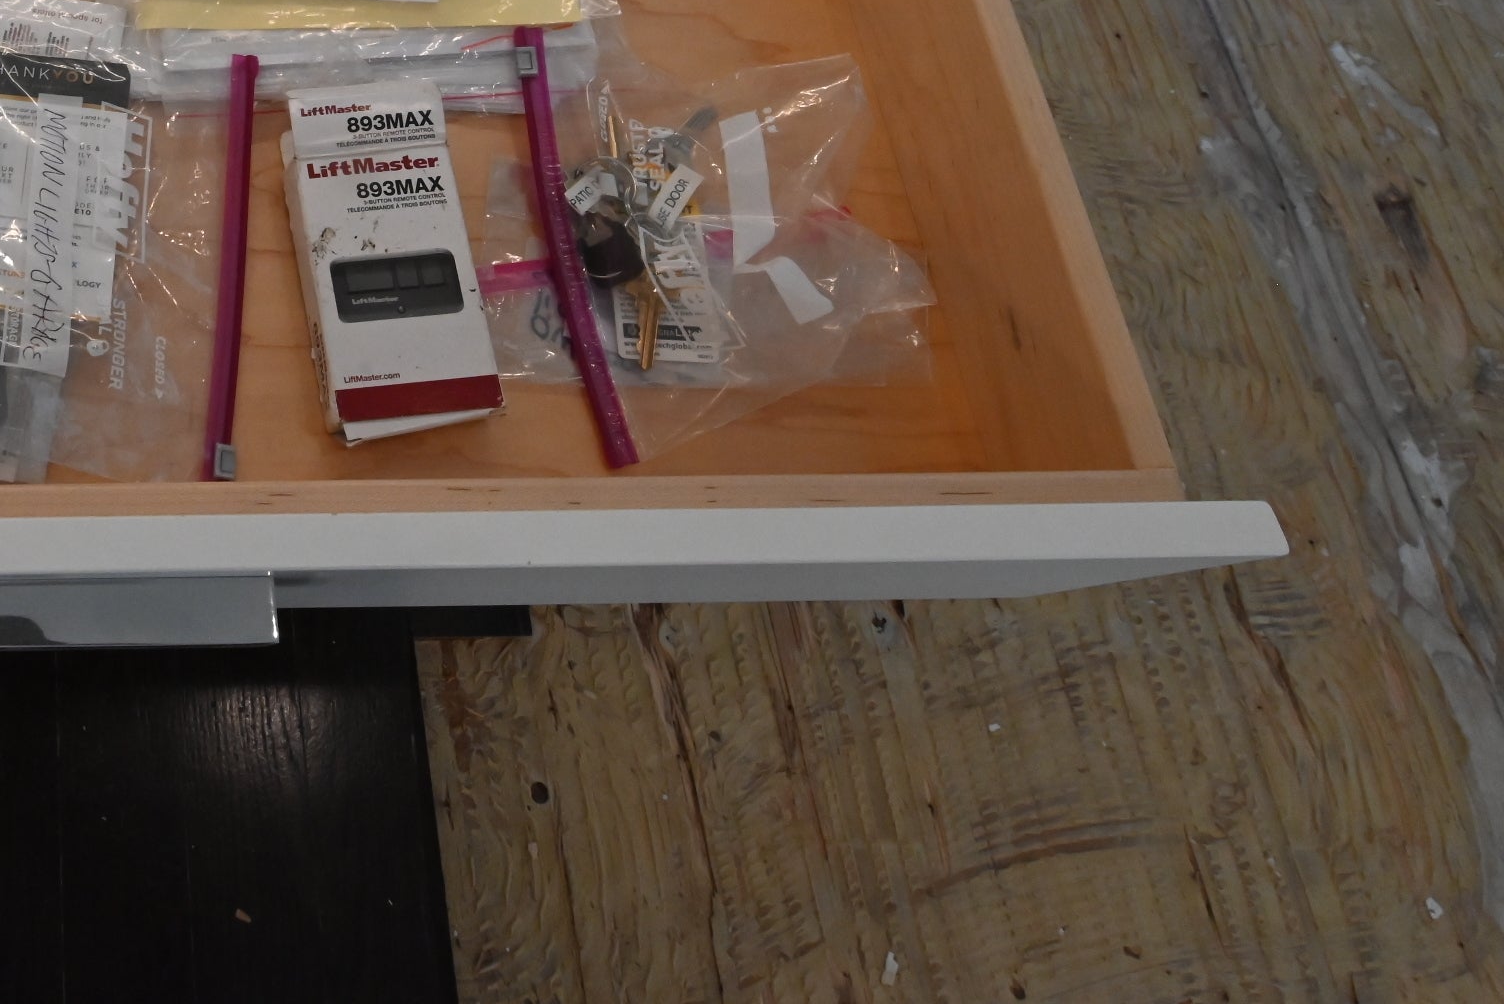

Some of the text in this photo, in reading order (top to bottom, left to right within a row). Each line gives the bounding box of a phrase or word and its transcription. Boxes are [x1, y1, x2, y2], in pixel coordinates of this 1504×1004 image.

[300, 103, 372, 118] LiftMaster
[346, 109, 435, 133] 893MAX
[382, 129, 407, 137] REMOTE
[407, 126, 434, 135] CONTROL
[390, 135, 407, 143] TROIS
[407, 133, 436, 142] BOUTONS
[39, 108, 69, 187] MOTION
[306, 154, 439, 180] LiftMaster
[356, 175, 445, 199] 893MAX
[393, 194, 418, 203] REMOTE
[417, 192, 446, 201] CONTROL
[569, 186, 595, 207] PATIO
[668, 177, 690, 209] DOOR
[401, 201, 419, 209] TROIS
[419, 198, 448, 207] BOUTONS
[75, 280, 102, 289] LOGY
[108, 298, 128, 390] STRONGER
[155, 336, 167, 385] CLOSED
[343, 371, 401, 384] LiftMaster.com
